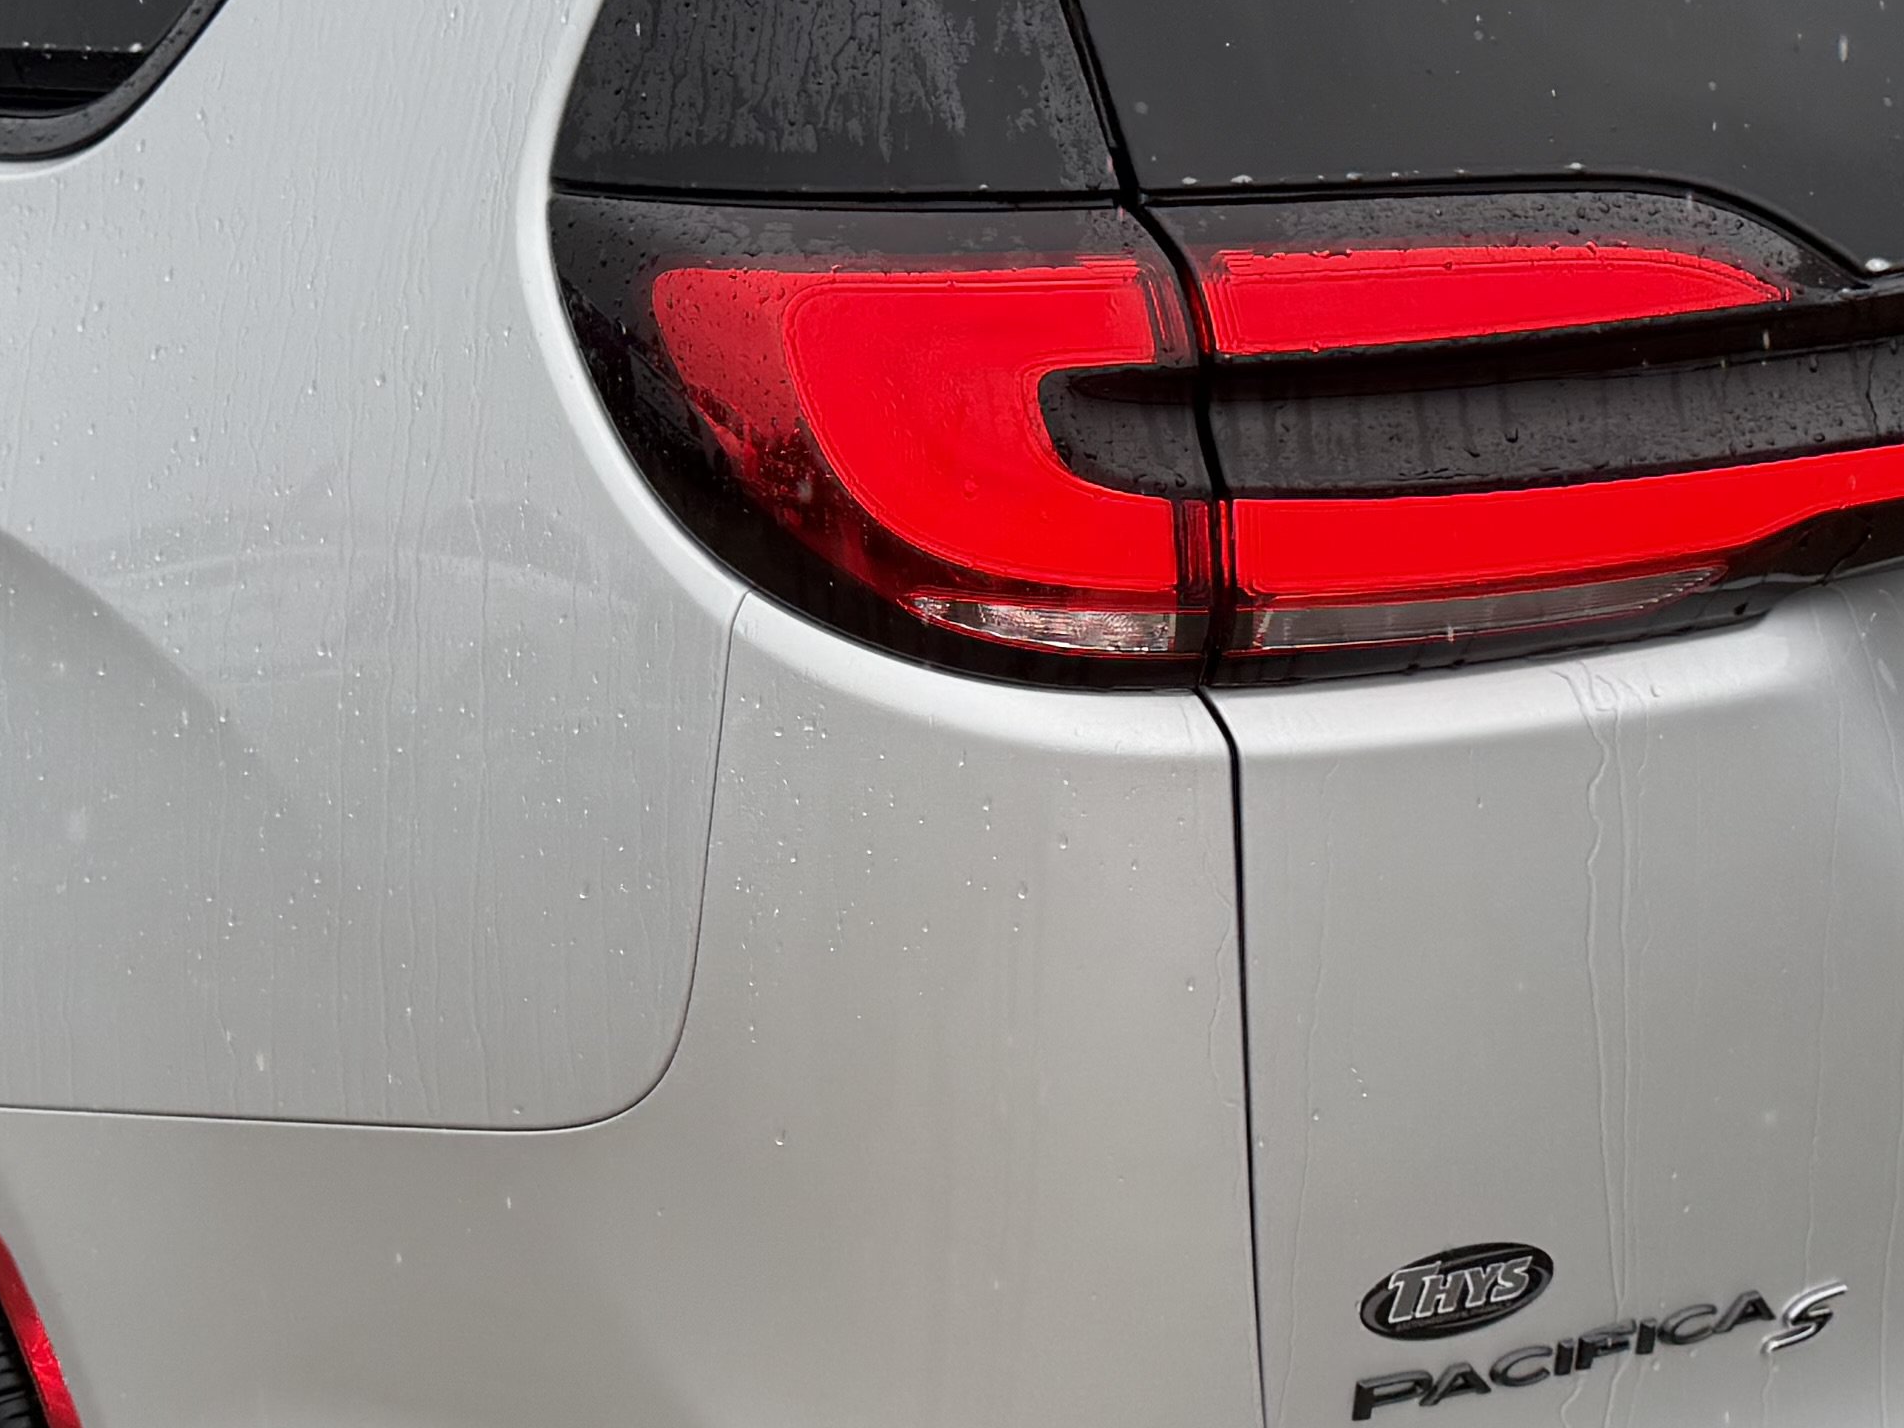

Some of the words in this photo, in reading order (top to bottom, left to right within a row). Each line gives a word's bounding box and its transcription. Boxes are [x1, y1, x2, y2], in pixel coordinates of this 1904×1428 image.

[1388, 1256, 1533, 1324] THYS
[1351, 1288, 1776, 1421] PACIFICA
[1759, 1280, 1849, 1355] S
